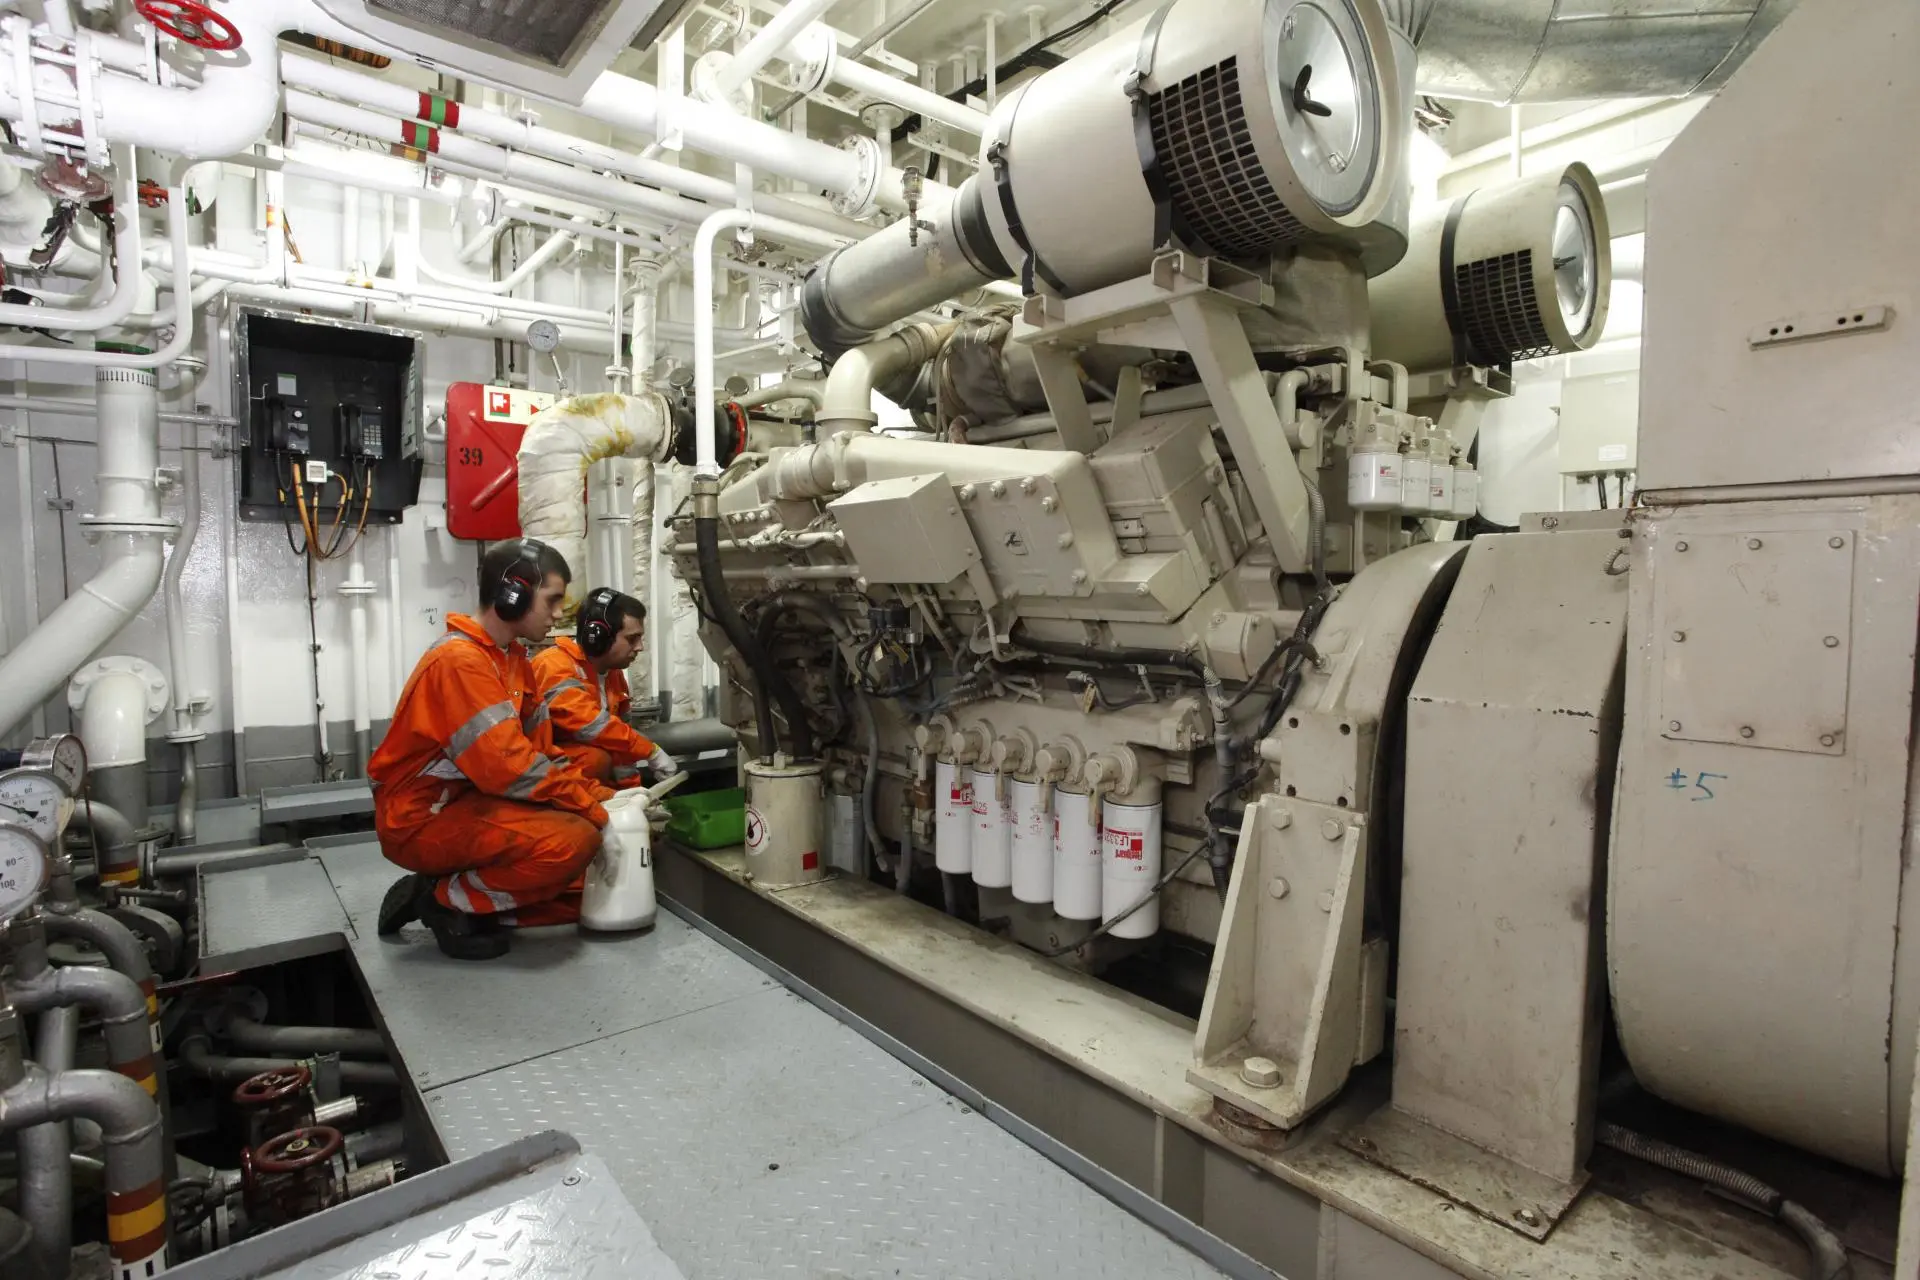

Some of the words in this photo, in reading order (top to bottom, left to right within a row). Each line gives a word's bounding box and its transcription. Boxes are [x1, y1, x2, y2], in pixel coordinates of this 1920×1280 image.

[459, 447, 484, 467] 39
[6, 858, 17, 867] 80
[0, 879, 15, 889] 100
